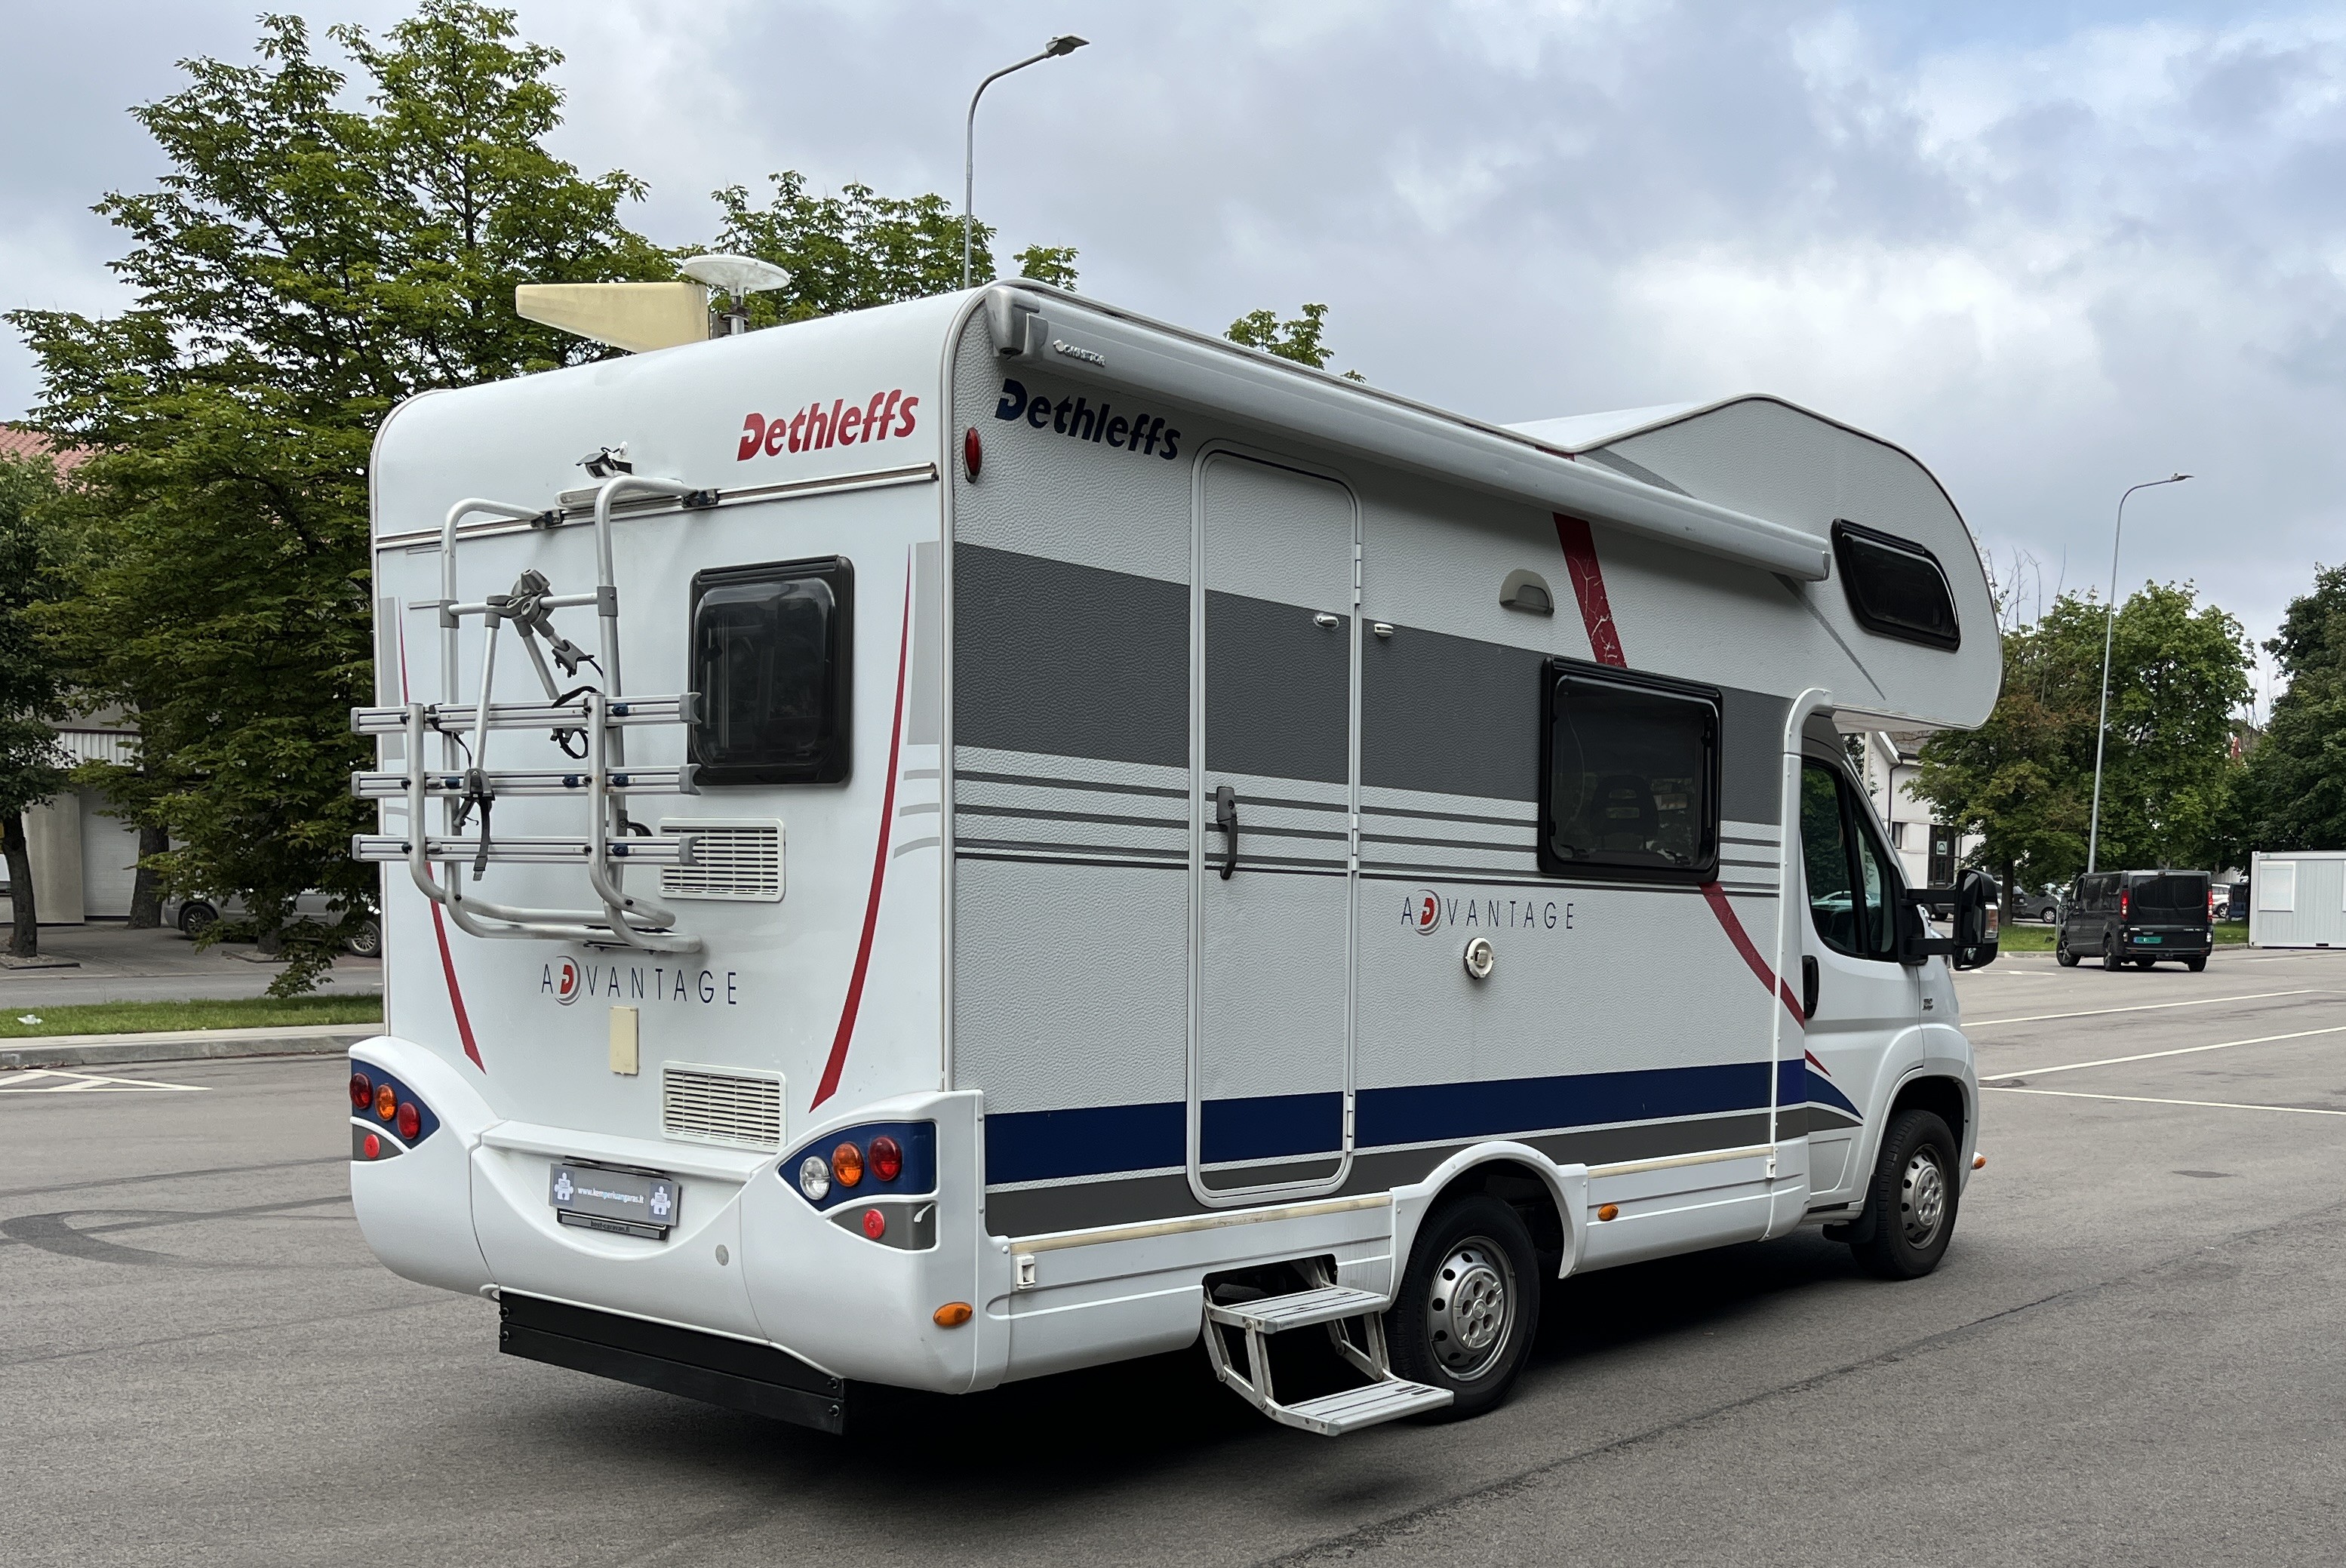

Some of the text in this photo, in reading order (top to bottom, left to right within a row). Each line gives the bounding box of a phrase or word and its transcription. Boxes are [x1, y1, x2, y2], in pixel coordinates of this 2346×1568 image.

[736, 389, 920, 462] Dethleffs
[995, 378, 1181, 460] Dethleffs
[1401, 893, 1574, 931] ADVANTAGE
[541, 960, 737, 1006] ADVANTAGE
